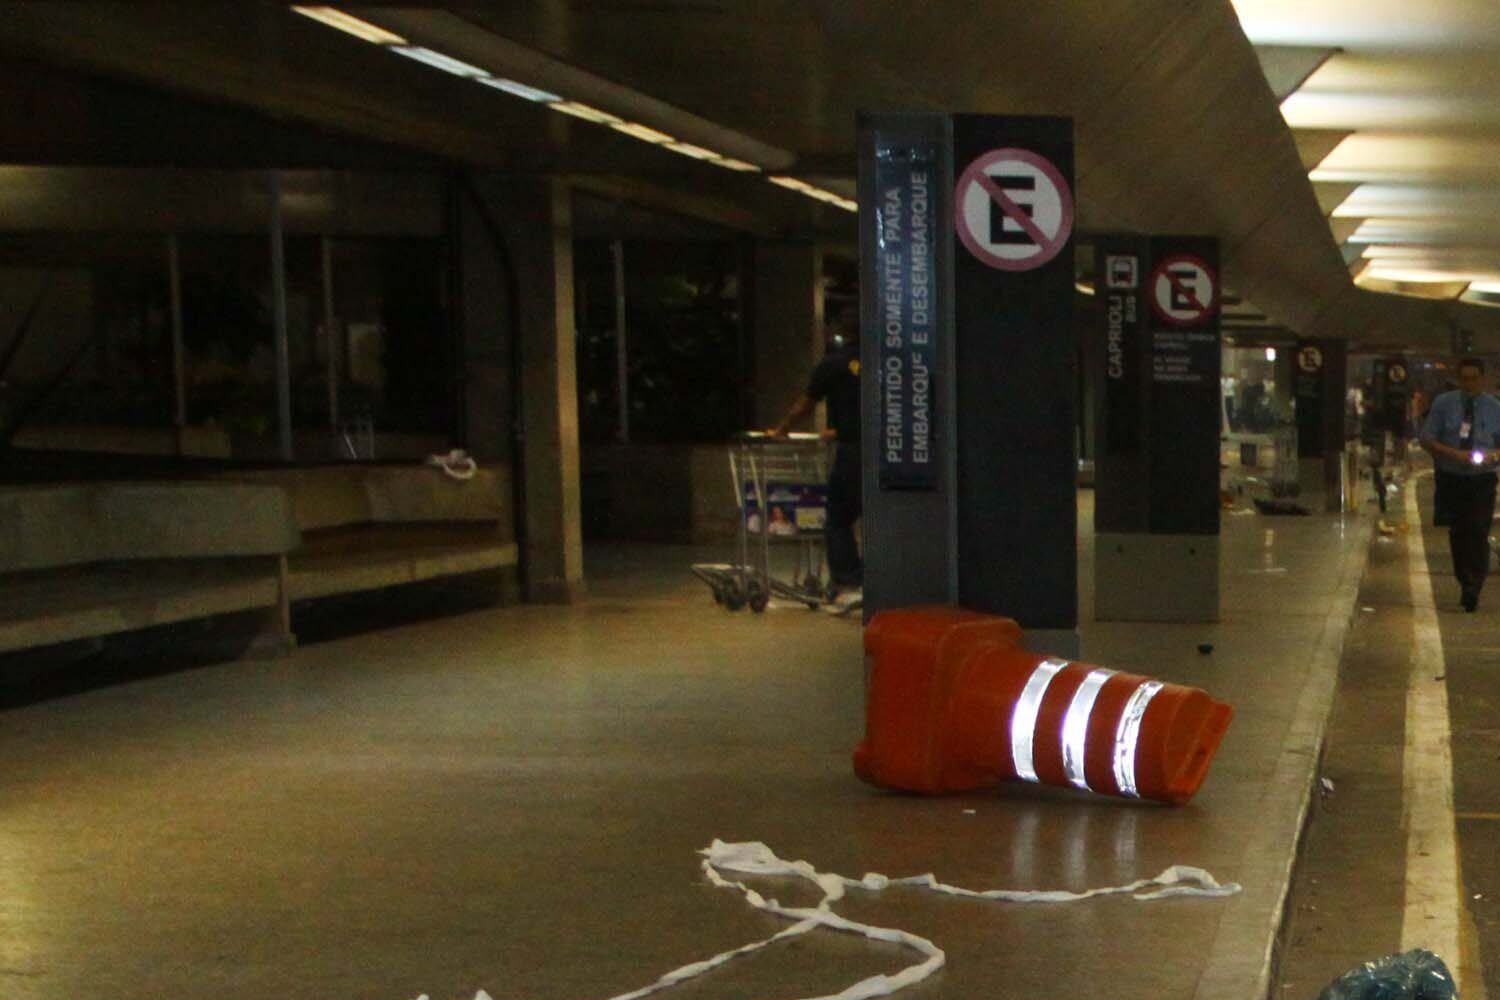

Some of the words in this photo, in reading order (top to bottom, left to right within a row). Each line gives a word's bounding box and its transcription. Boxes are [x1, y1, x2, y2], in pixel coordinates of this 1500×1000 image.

[885, 188, 902, 242] PARA
[911, 171, 928, 321] DESEMBARQUE
[886, 254, 903, 348] SOMENTE
[912, 330, 928, 345] E
[1108, 295, 1123, 379] CAPRIOLI
[887, 355, 903, 463] PERMITIDO
